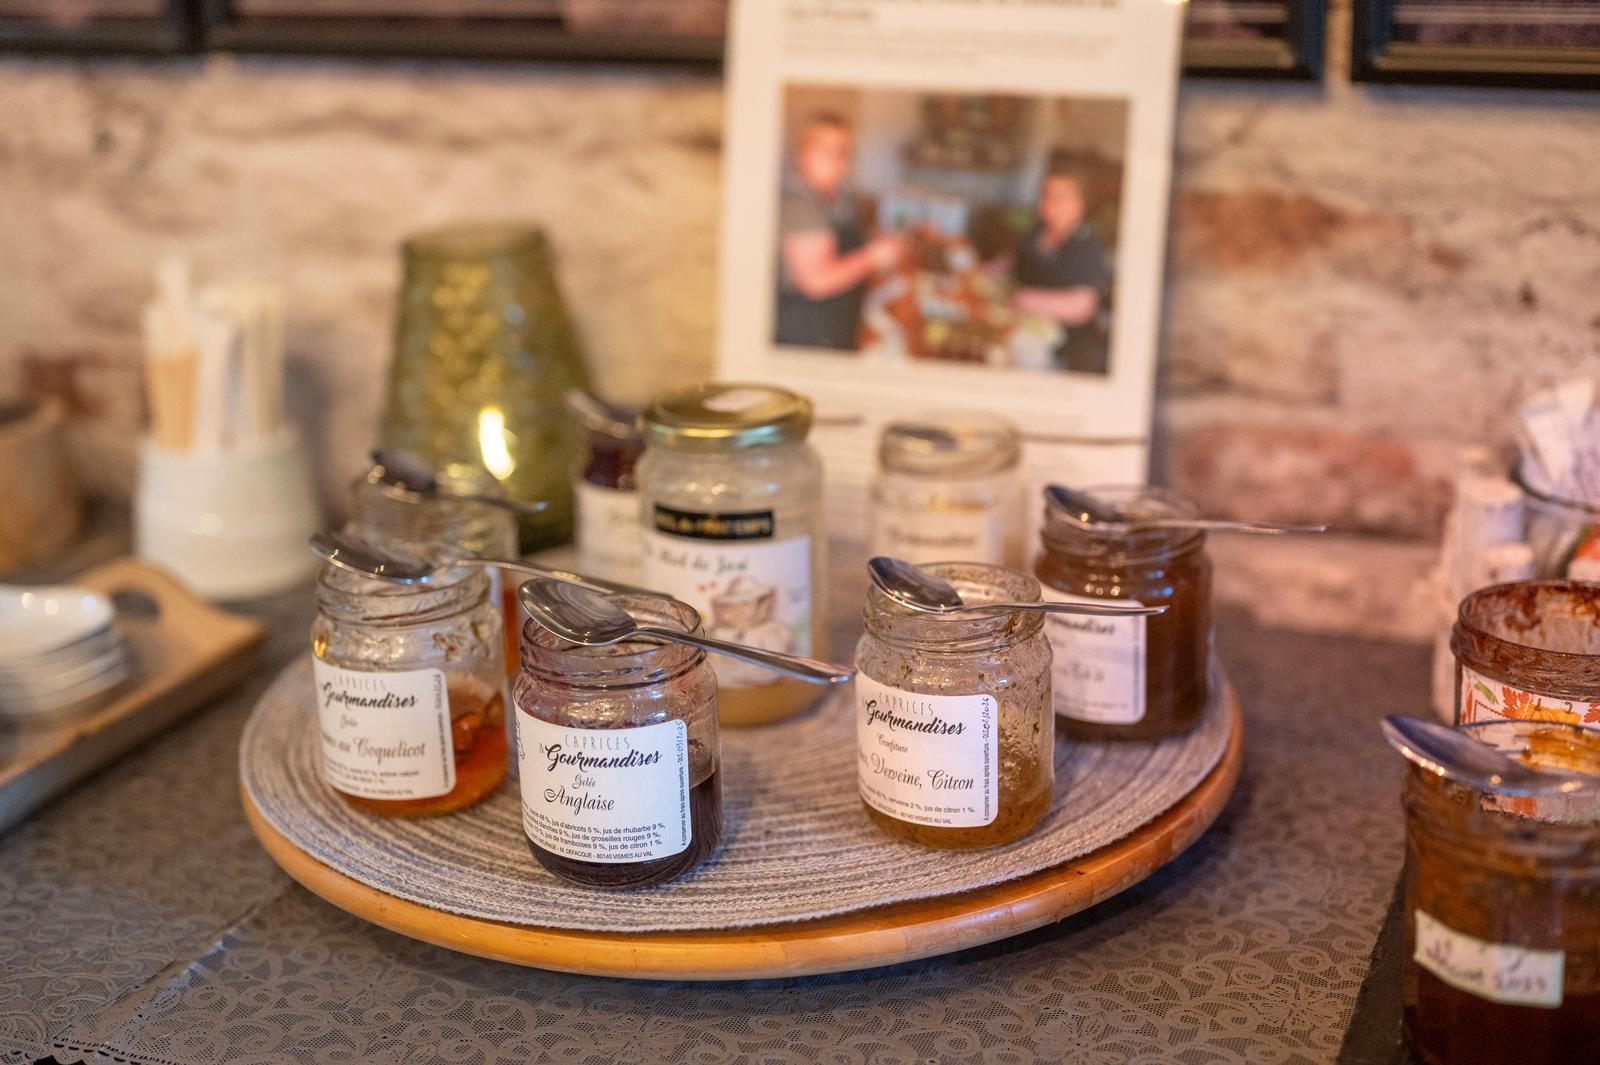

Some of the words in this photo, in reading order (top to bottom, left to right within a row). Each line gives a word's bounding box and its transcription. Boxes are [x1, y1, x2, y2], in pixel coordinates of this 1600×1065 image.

[322, 682, 418, 710] Gourmandises
[880, 692, 934, 716] CAPRICES
[865, 700, 966, 734] Gourmandises
[352, 736, 426, 766] Coquelicot
[565, 734, 630, 750] CAPRICES
[876, 732, 909, 754] Confiture
[544, 744, 662, 772] Gourmandises
[870, 752, 922, 790] Verveine,
[926, 770, 974, 790] Citron
[572, 774, 596, 789] Gelée
[544, 785, 615, 816] Anglaise
[591, 834, 621, 842] groseilles
[623, 826, 651, 834] rhubarbe
